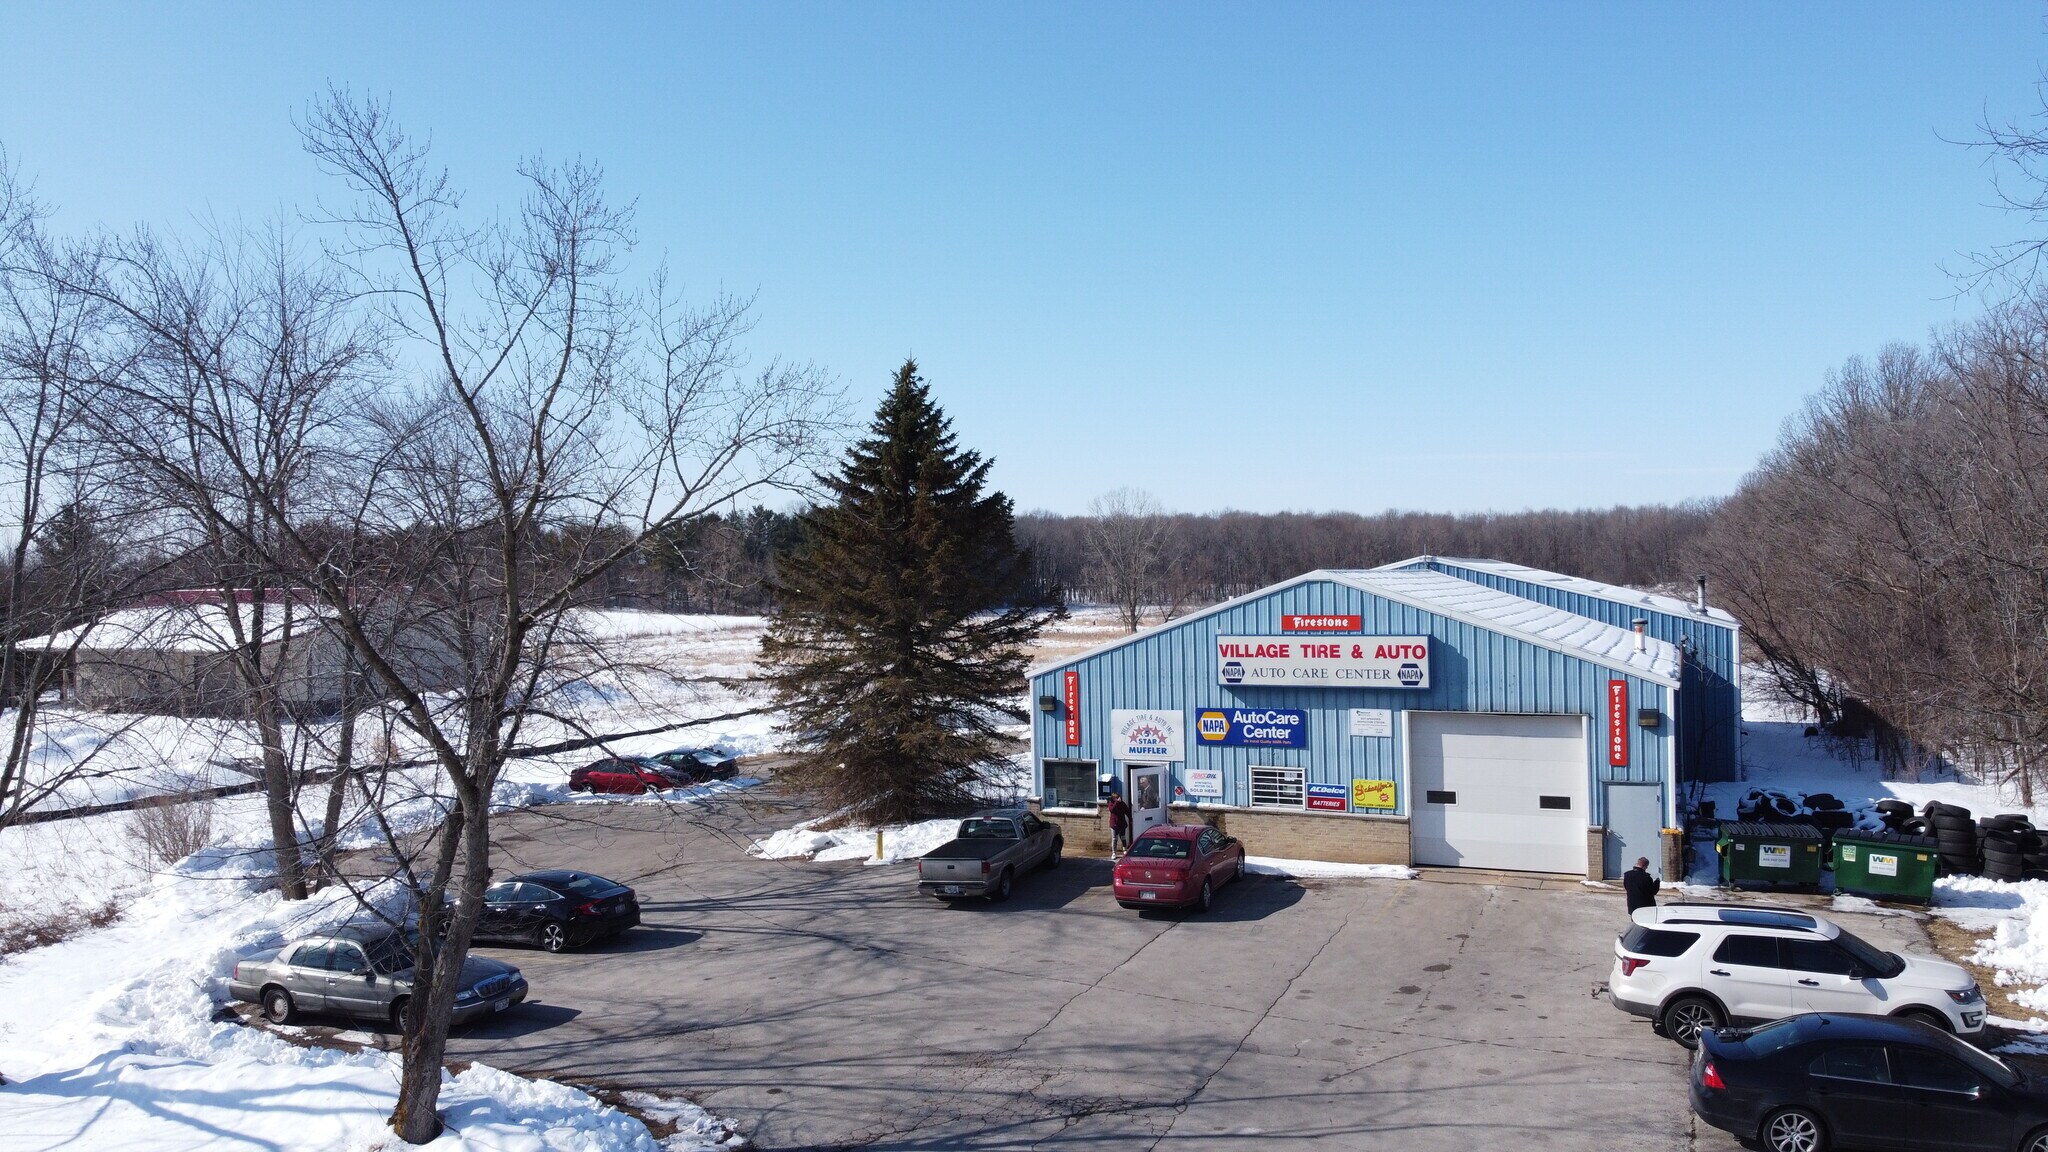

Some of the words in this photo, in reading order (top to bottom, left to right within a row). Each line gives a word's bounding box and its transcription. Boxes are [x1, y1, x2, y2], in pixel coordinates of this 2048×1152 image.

[1293, 617, 1349, 628] Firestone
[1219, 644, 1290, 658] VILLAGE
[1300, 644, 1341, 659] TIRE
[1351, 644, 1363, 659] &
[1375, 644, 1426, 660] AUTO
[1225, 666, 1242, 678] NAPA
[1251, 667, 1286, 678] AUTO
[1292, 668, 1329, 679] CARE
[1335, 668, 1392, 680] CENTER
[1401, 668, 1420, 680] NAPA
[1067, 676, 1075, 740] Firestone
[1233, 710, 1299, 725] AutoCare
[1612, 685, 1622, 760] Firestone
[1202, 719, 1225, 733] NAPA
[1243, 725, 1291, 739] Center
[1144, 730, 1151, 738] 5
[1128, 746, 1168, 755] MUFFLER
[1309, 786, 1345, 794] ACDelco
[1763, 846, 1786, 855] WM
[1872, 855, 1894, 864] WM
